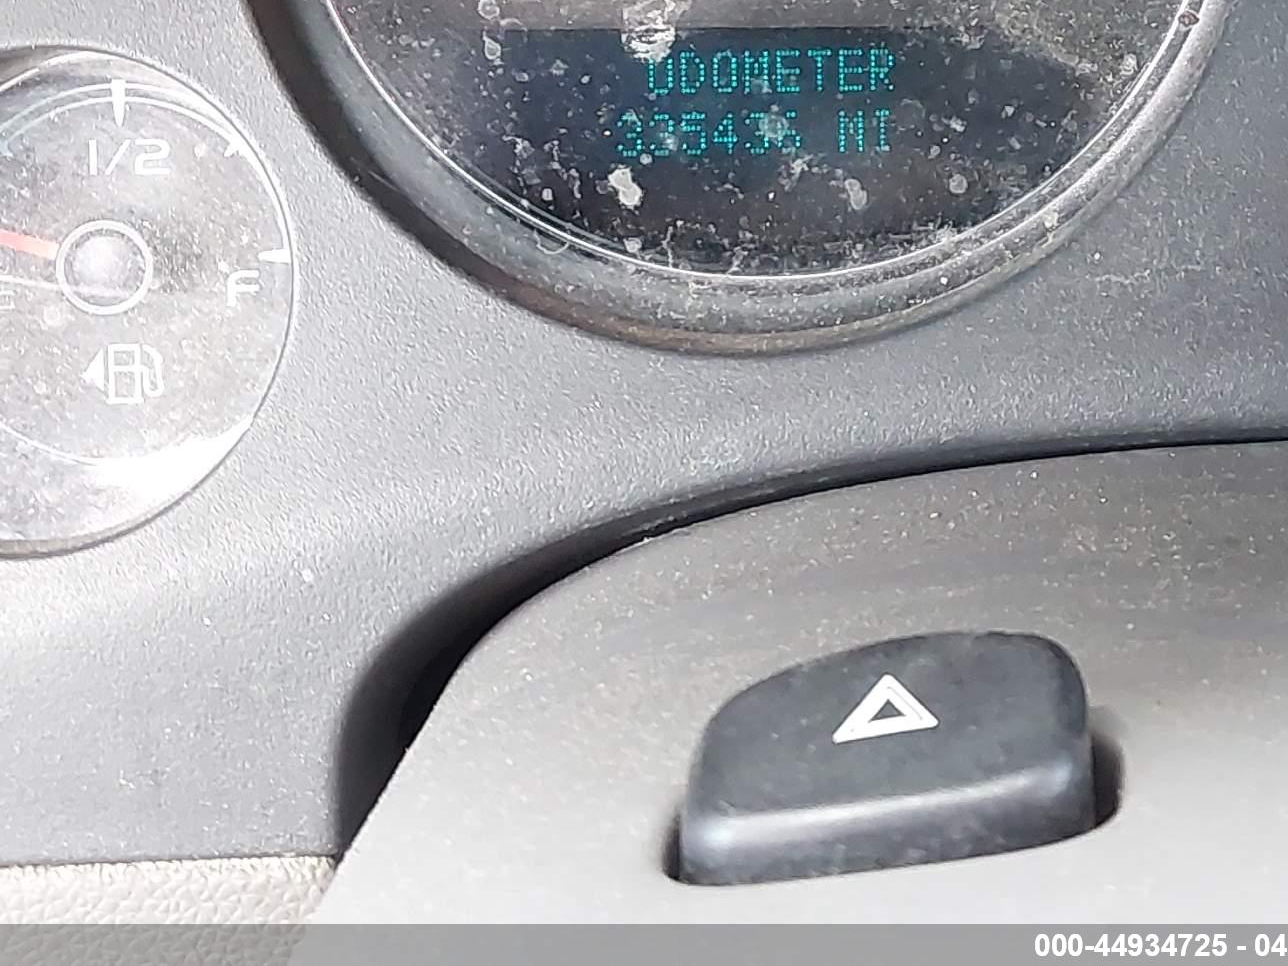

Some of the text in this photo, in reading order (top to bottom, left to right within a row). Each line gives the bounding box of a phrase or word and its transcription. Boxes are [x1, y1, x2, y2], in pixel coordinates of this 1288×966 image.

[648, 48, 896, 94] ODOMETER
[837, 109, 890, 153] MI
[87, 139, 171, 175] 1/2
[227, 270, 260, 307] F
